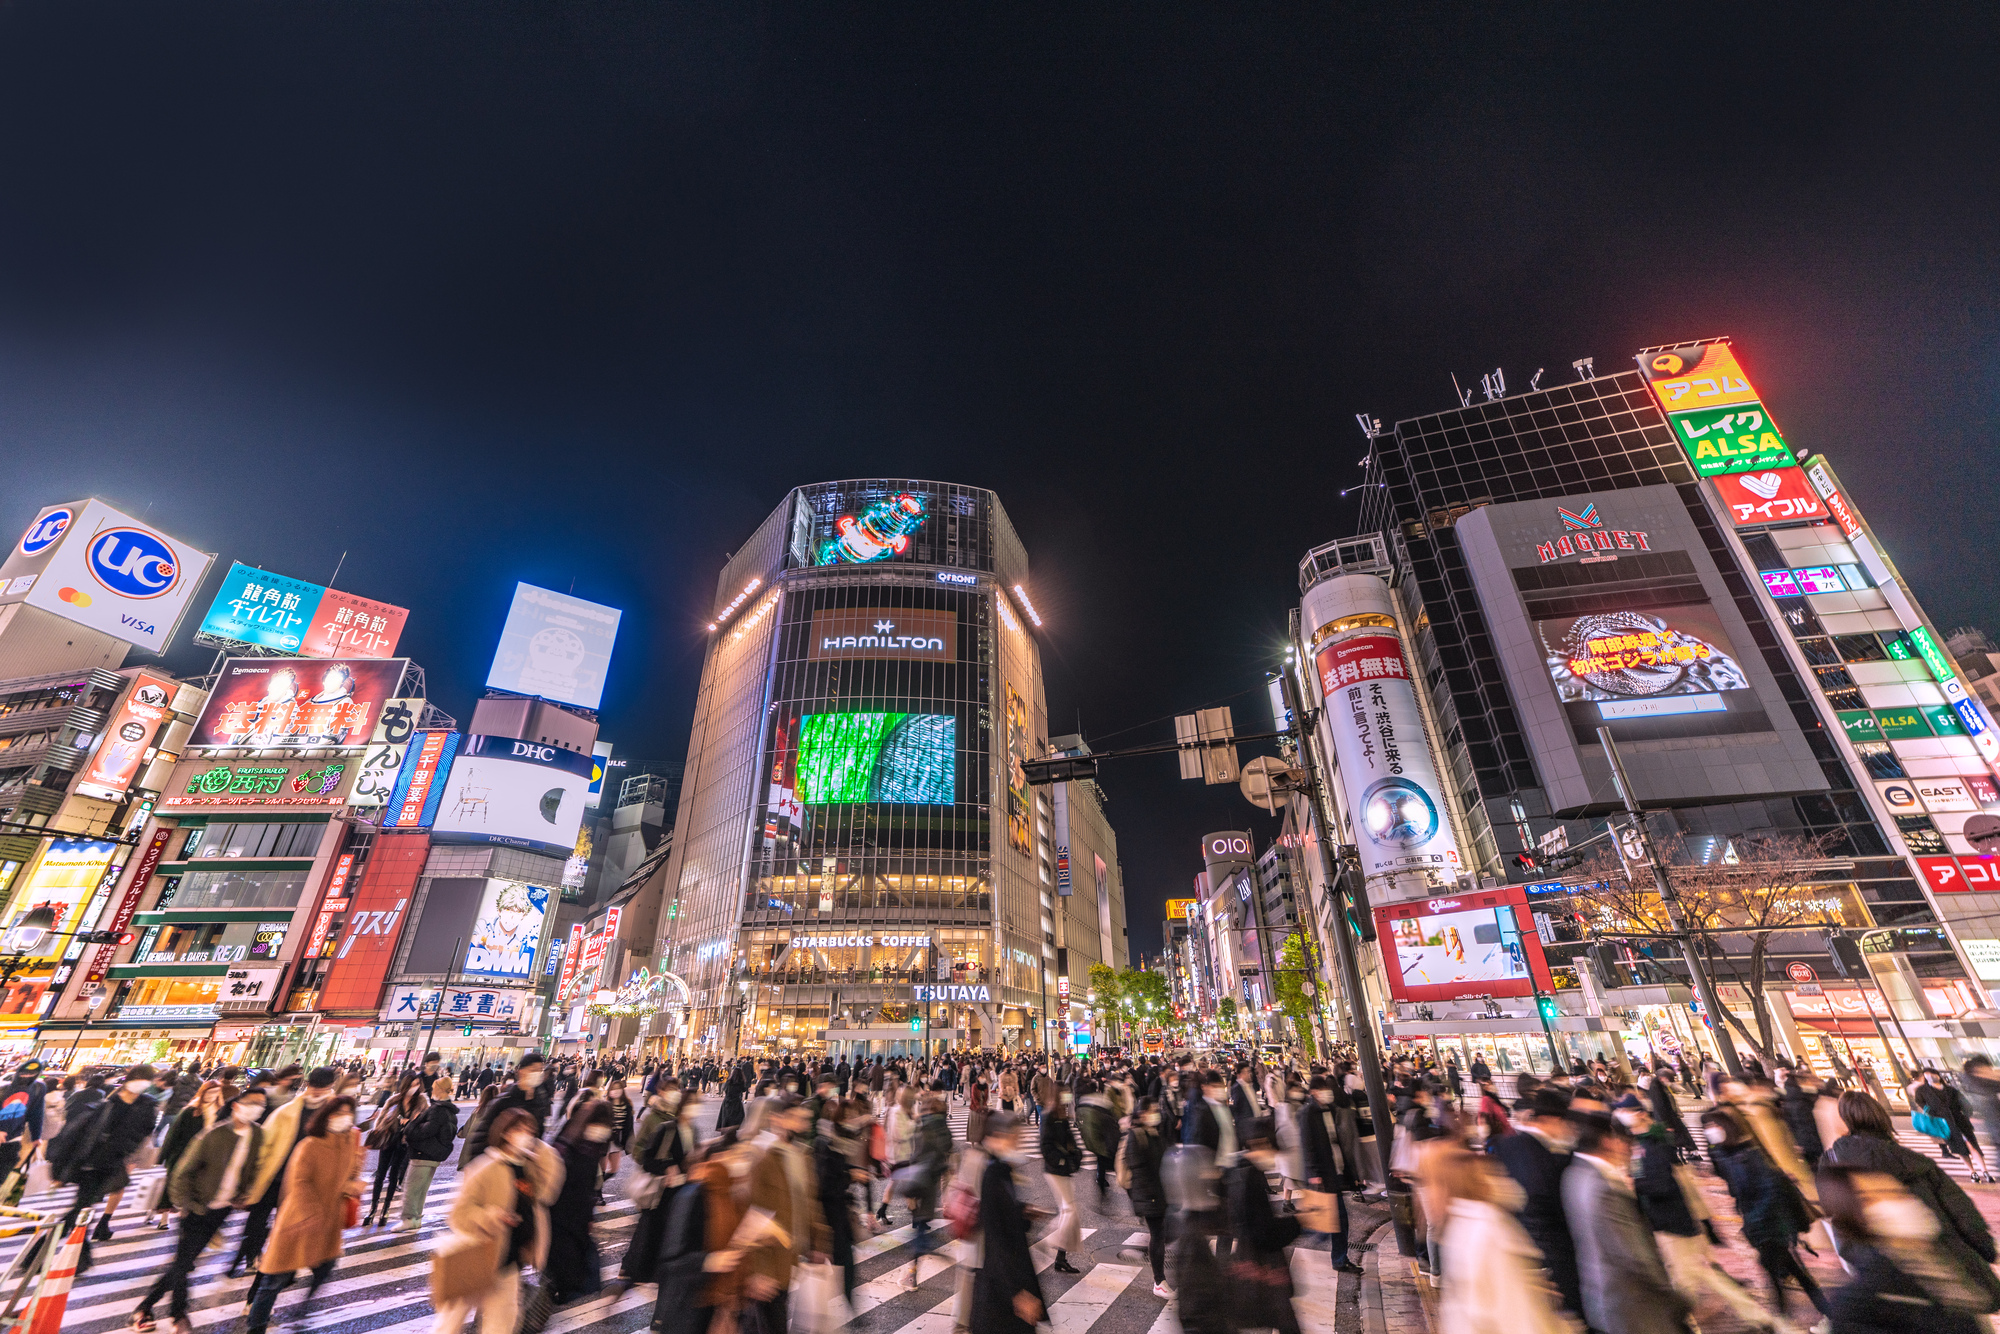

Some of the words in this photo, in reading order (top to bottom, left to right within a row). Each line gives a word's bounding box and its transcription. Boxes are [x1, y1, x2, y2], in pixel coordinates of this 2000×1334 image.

[1663, 375, 1750, 401] アコム
[1680, 410, 1762, 438] レイク
[1695, 432, 1783, 459] ALSA
[1732, 497, 1817, 520] アイフル
[1536, 530, 1651, 564] MAGNET
[938, 573, 976, 585] QFRONT
[1762, 572, 1789, 585] チア
[1796, 568, 1834, 582] ガール
[242, 583, 302, 612] 龍角散
[120, 613, 156, 636] VISA
[228, 599, 302, 629] ダイレクト
[334, 606, 388, 634] 龍角散
[323, 622, 390, 650] ダイレクト
[824, 636, 943, 651] HAMILTON
[1586, 630, 1675, 655] 南部鉄瓶で
[1337, 644, 1374, 658] Demaecan
[1323, 656, 1404, 692] 送料無料
[213, 700, 371, 736] 送料無料
[1368, 683, 1402, 774] それ、渋谷に来る
[1842, 718, 1874, 730] レイク
[1882, 716, 1918, 727] ALSA
[1938, 714, 1958, 726] 5F
[356, 700, 414, 804] もんじゃ
[512, 742, 556, 762] DHC
[229, 775, 284, 794] 西村
[400, 736, 442, 821] 三千里薬品
[1920, 787, 1962, 796] EAST
[1058, 846, 1070, 886] SEIBU
[1428, 900, 1461, 914] Glico
[792, 936, 874, 948] STARBUCKS
[880, 936, 930, 947] COFFEE
[465, 946, 531, 974] DMM
[914, 985, 990, 1002] TSUTAYA
